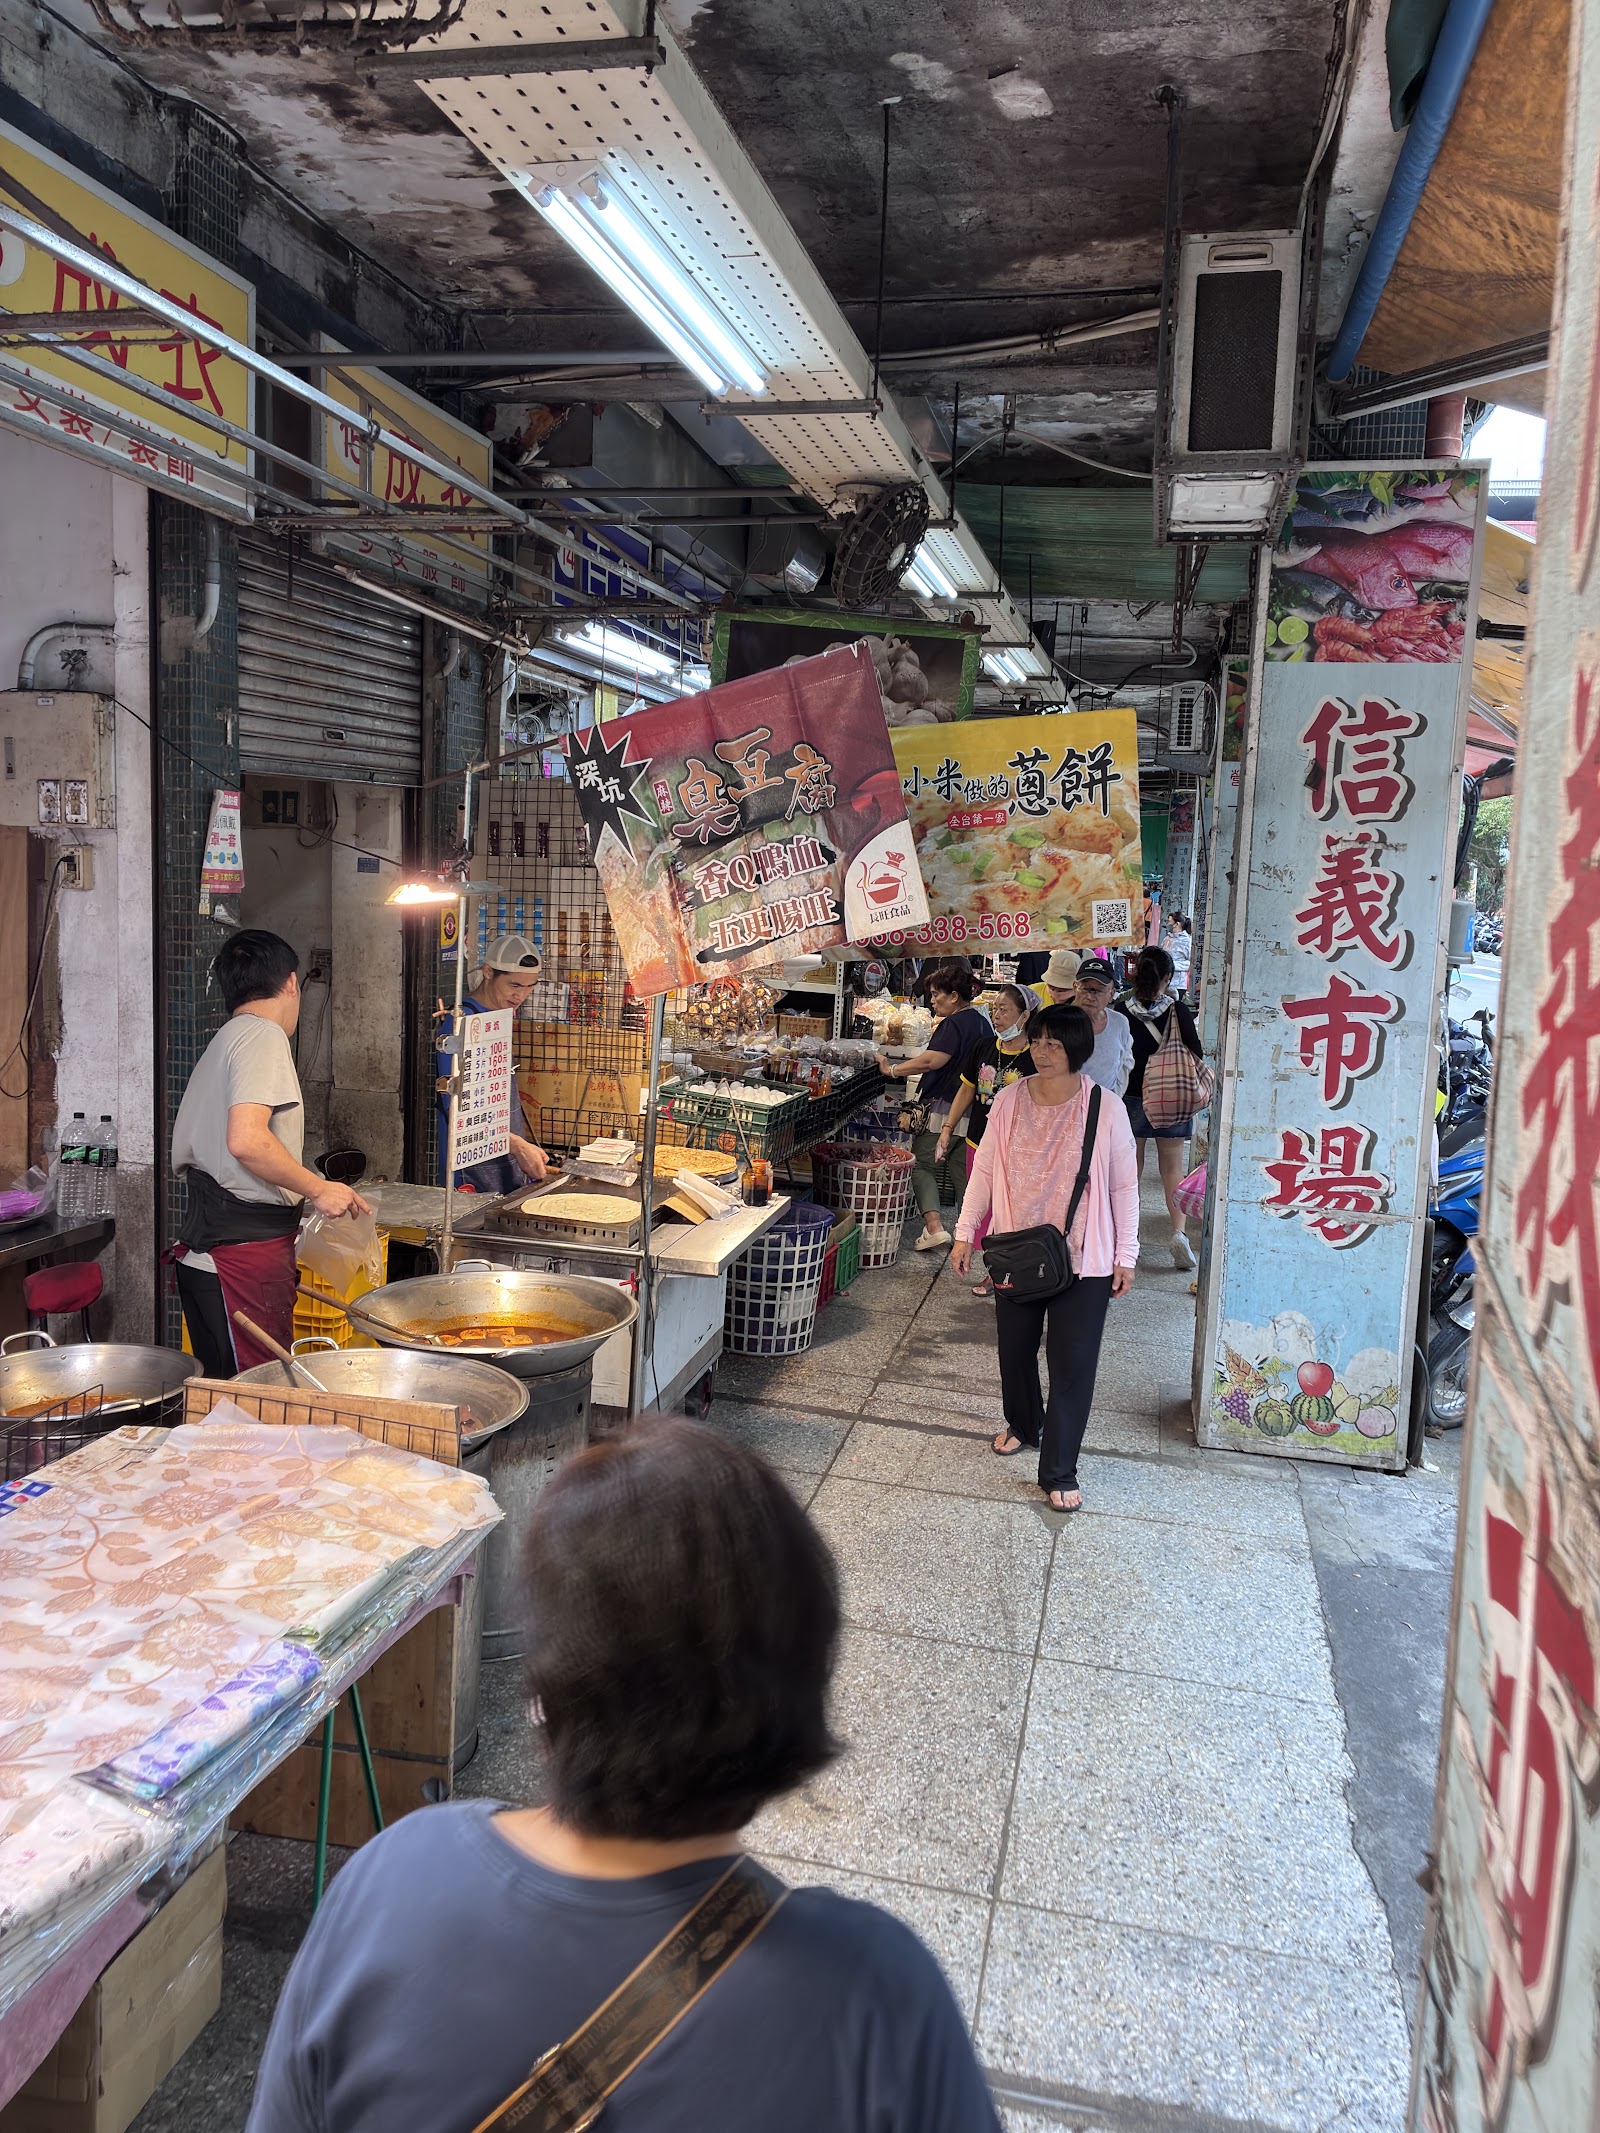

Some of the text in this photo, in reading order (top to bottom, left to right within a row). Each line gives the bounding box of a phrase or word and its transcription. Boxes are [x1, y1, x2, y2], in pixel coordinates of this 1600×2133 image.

[575, 759, 625, 805] 深坑
[655, 784, 673, 812] 麻辣
[673, 728, 836, 844] 臭豆腐
[949, 812, 1005, 827] 全台第一家
[694, 836, 828, 902] 香Q鴨血
[709, 888, 840, 953] 五更腸旺
[1263, 697, 1426, 1247] 信義市場
[456, 1138, 507, 1165] 0906376031
